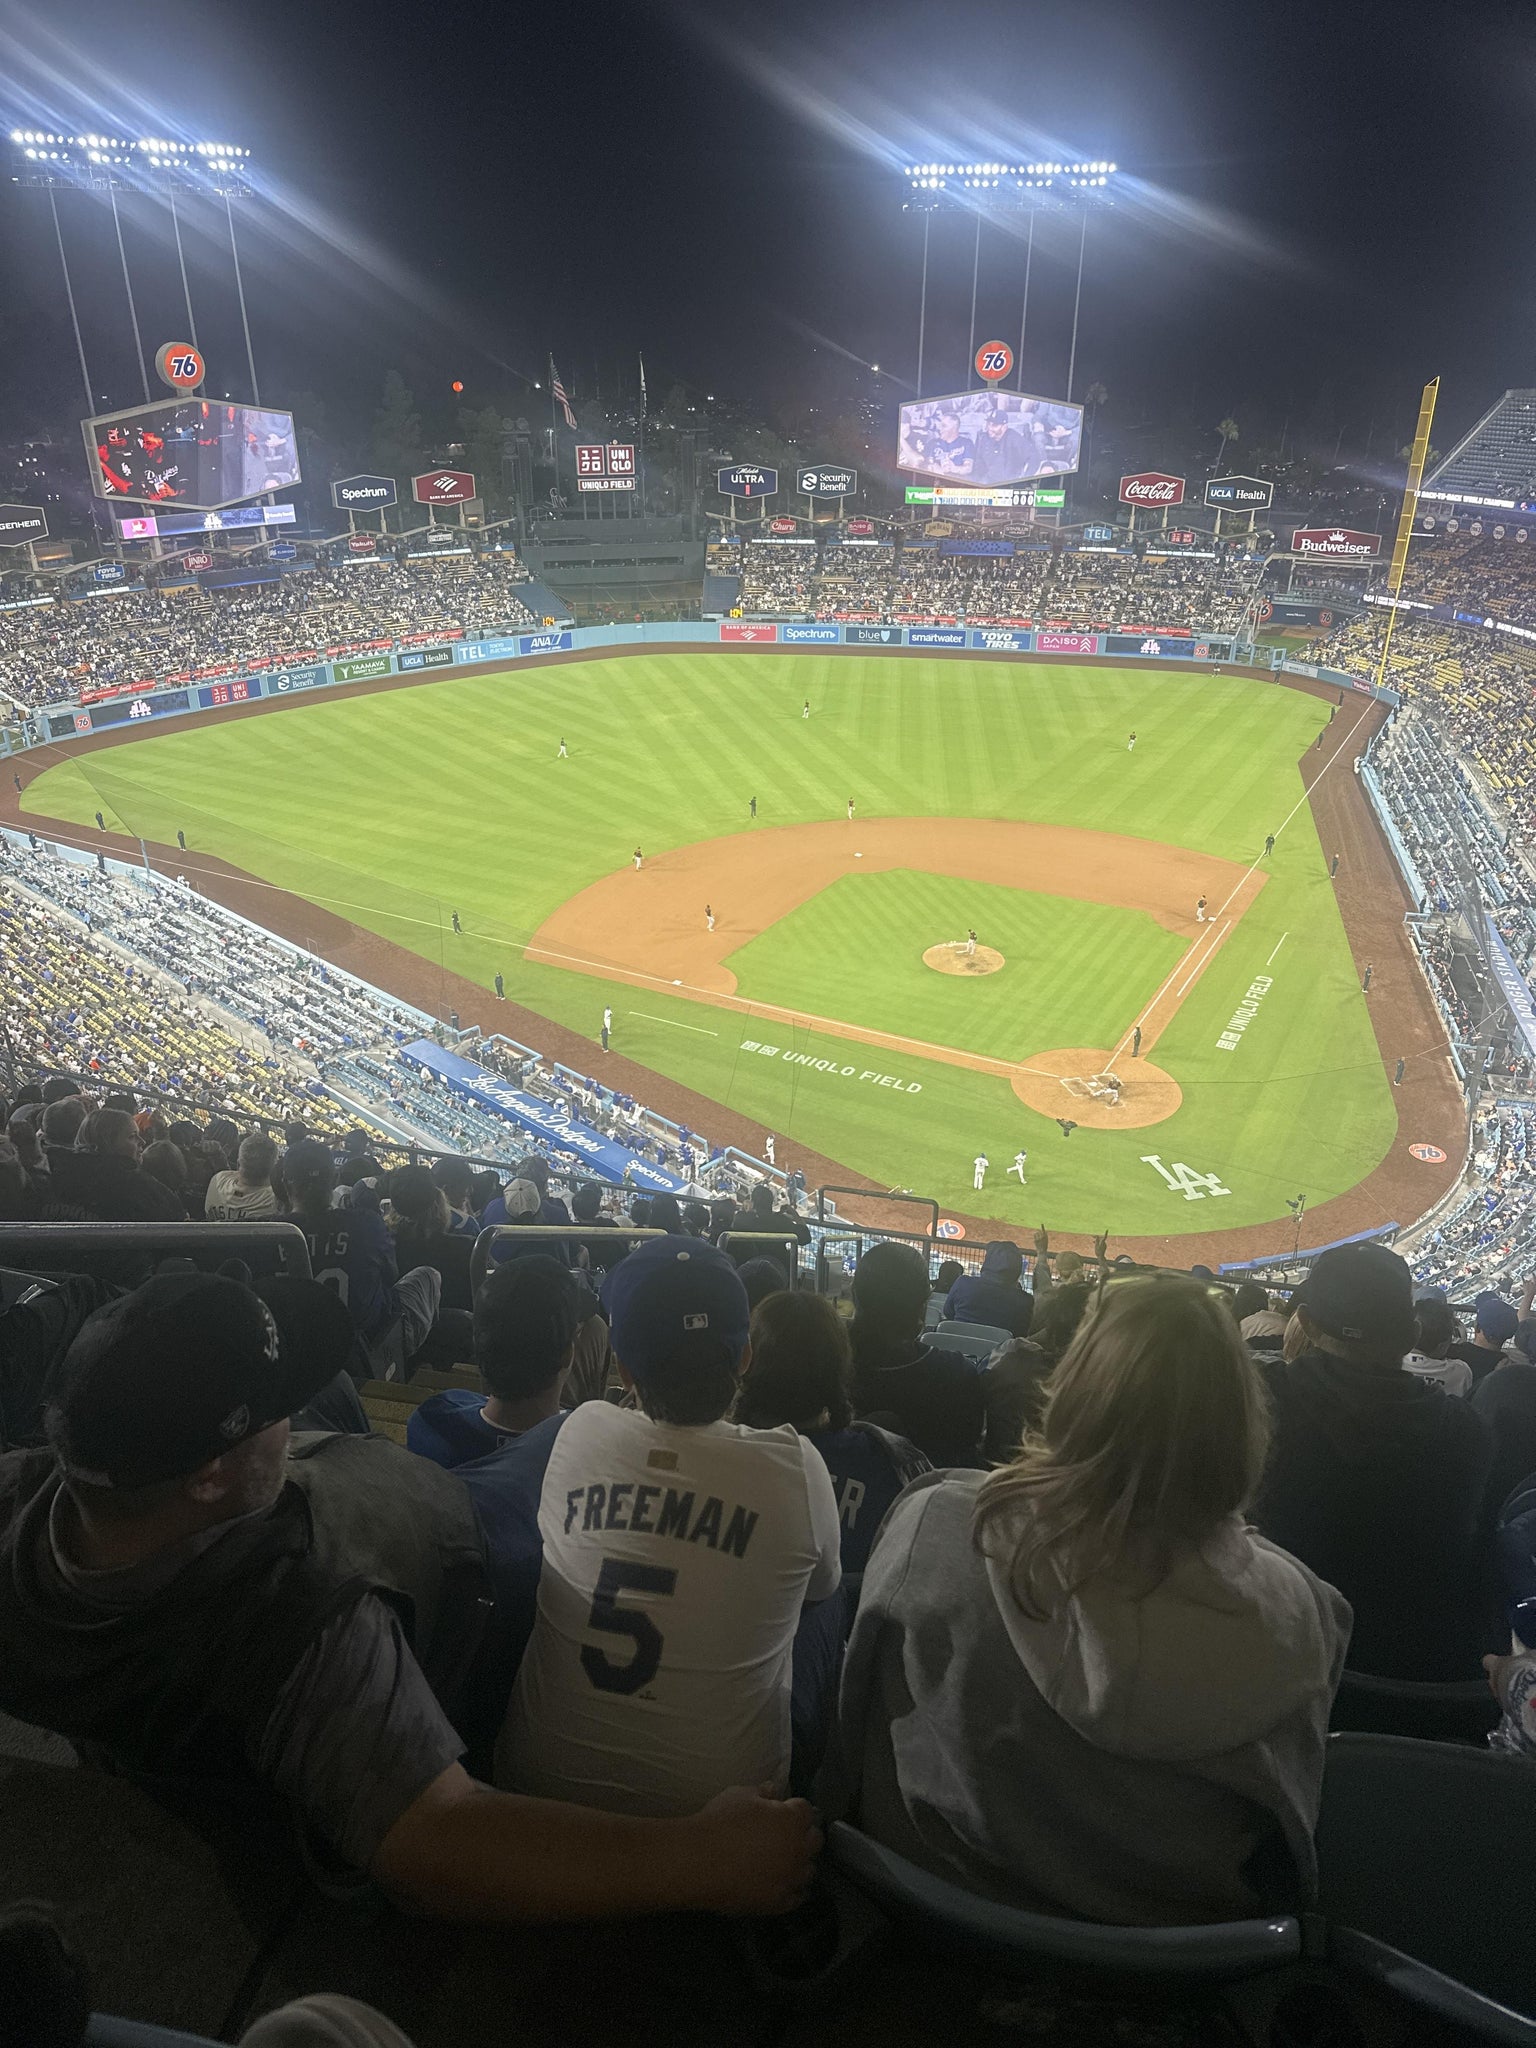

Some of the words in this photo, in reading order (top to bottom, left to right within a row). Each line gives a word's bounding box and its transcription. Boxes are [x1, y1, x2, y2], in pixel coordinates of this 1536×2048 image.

[171, 354, 197, 378] 76
[982, 350, 1006, 371] 76
[611, 449, 630, 460] UNI
[611, 460, 632, 471] QLO
[731, 474, 765, 484] ULTRA
[819, 472, 851, 484] Security
[581, 480, 609, 490] UNIQLO
[610, 480, 633, 489] FIELD
[819, 482, 847, 492] Benefit
[341, 487, 388, 500] Spectrum
[1210, 489, 1232, 498] UCLA
[1235, 488, 1266, 500] Health
[1088, 528, 1108, 539] TEL
[97, 567, 116, 575] TOYO
[786, 628, 831, 643] Spectrum
[858, 629, 880, 639] blue
[911, 633, 963, 644] smartwater
[981, 632, 1013, 641] TOYO
[530, 637, 551, 648] ANA
[985, 640, 1019, 649] TIRES
[405, 657, 422, 666] UCLA
[425, 652, 449, 663] Health
[460, 646, 486, 661] TEL
[290, 671, 317, 681] Security
[232, 683, 245, 692] UNI
[292, 678, 315, 688] Benefit
[1226, 999, 1260, 1031] UNIQLO
[1245, 975, 1274, 1000] FIELD
[782, 1050, 856, 1077] UNIQLO
[858, 1070, 923, 1094] FIELD
[485, 1088, 544, 1122] Angeles
[539, 1114, 605, 1153] Dodgers
[1415, 1146, 1441, 1159] 76
[626, 1159, 670, 1188] Spectrum
[1139, 1154, 1232, 1201] LA
[563, 1482, 760, 1560] FREEMAN
[579, 1556, 680, 1695] 5
